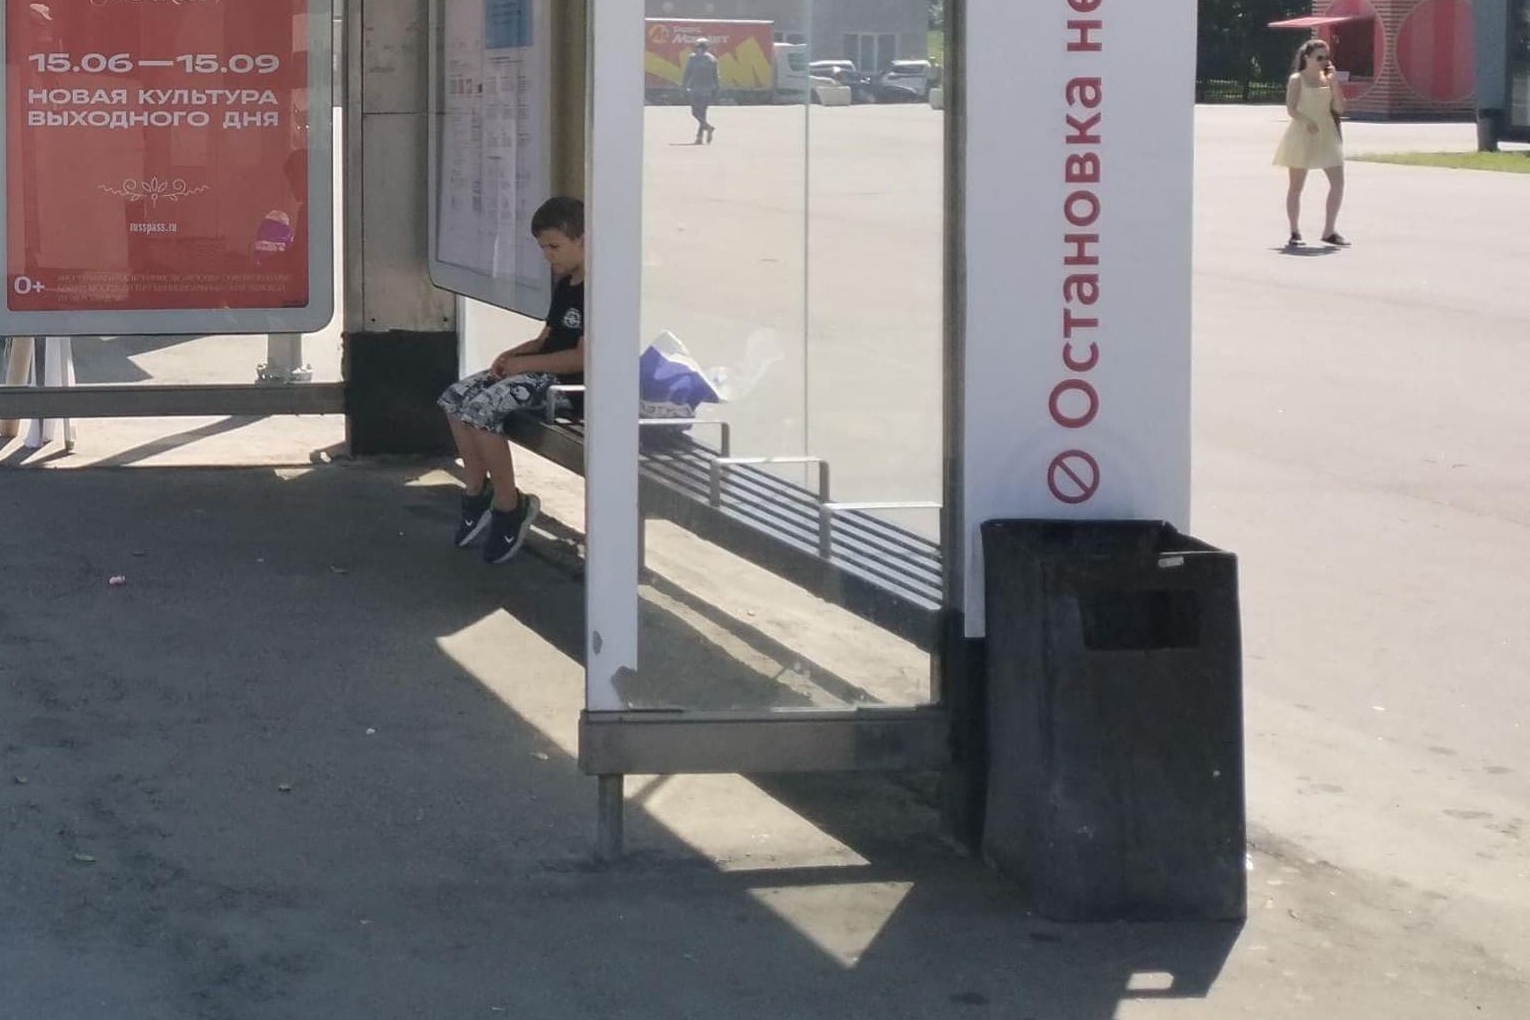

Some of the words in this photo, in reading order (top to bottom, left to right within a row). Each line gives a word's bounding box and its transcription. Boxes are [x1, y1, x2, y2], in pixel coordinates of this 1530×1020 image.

[28, 89, 127, 105] НОВАЯ
[138, 89, 278, 106] КУЛЬТУРА
[28, 111, 210, 129] ВЫХОДНОГО
[222, 111, 278, 129] ДНЯ
[130, 222, 177, 236] russpass.ru
[1048, 76, 1103, 429] Остановка
[14, 276, 45, 295] 0+
